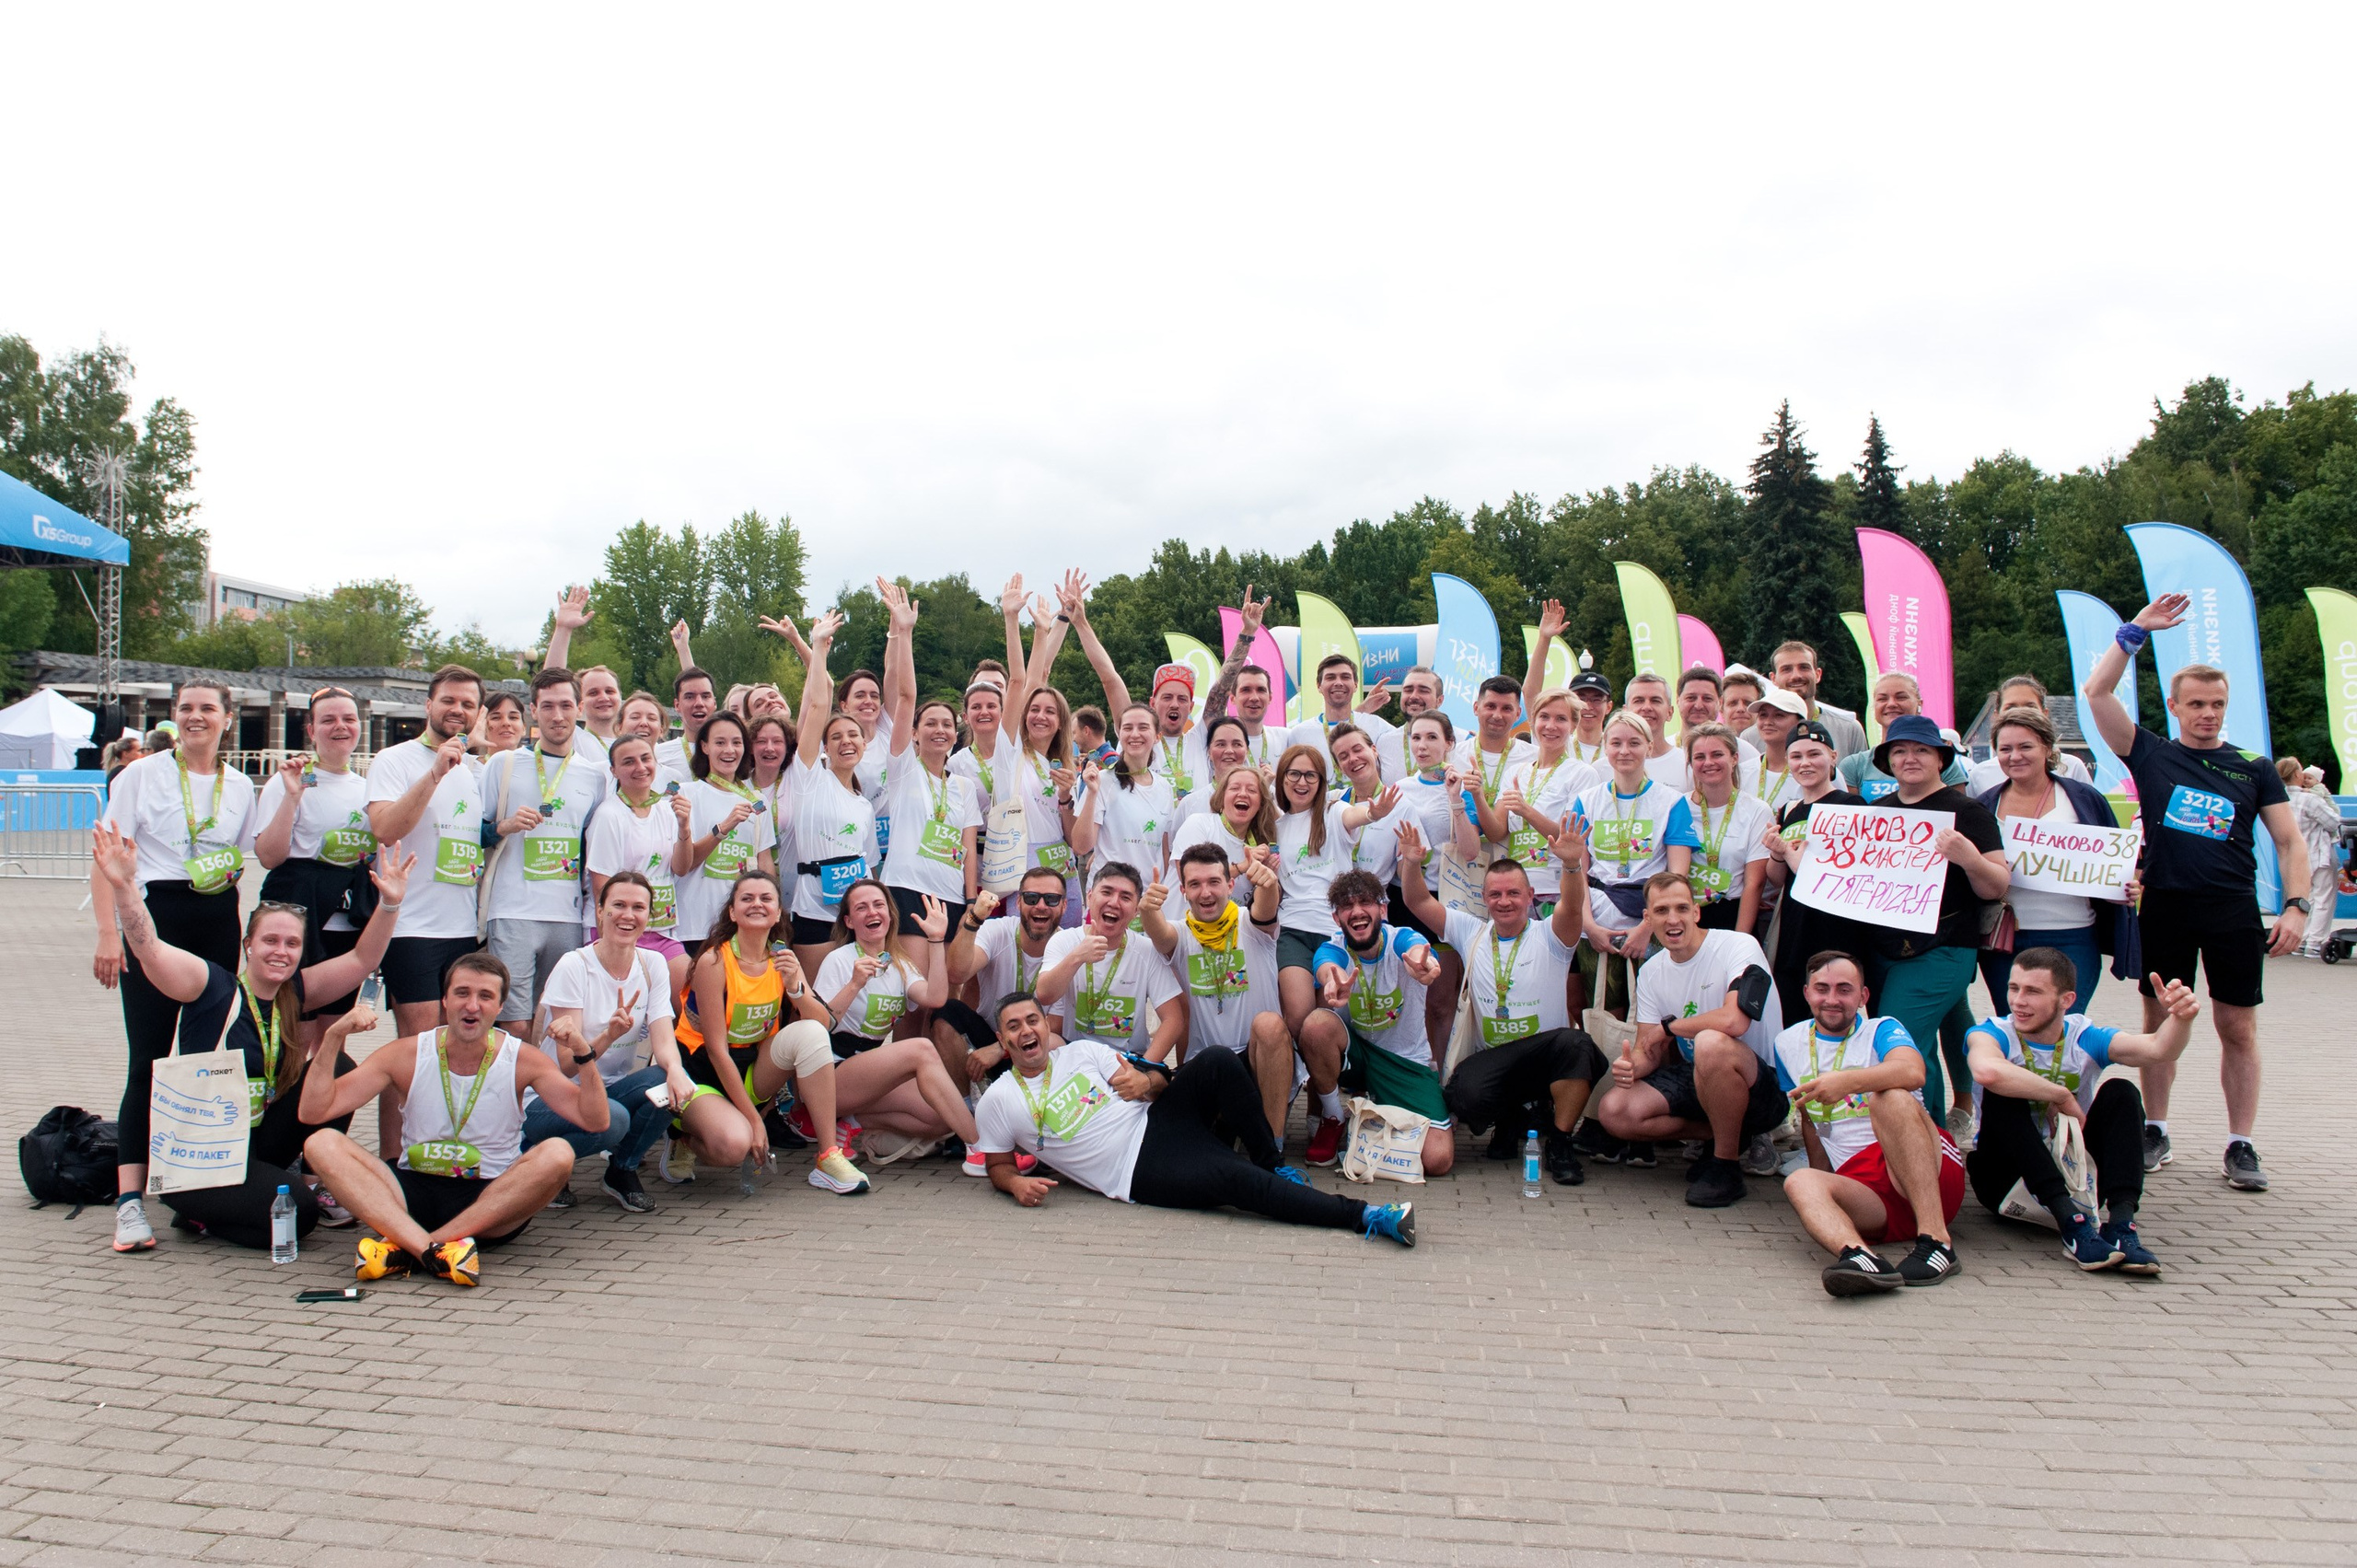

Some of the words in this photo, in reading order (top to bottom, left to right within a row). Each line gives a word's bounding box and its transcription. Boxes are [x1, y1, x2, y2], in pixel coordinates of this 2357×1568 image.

[1363, 646, 1399, 668] ИЗНИ
[2181, 790, 2223, 813] 3212
[1603, 822, 1643, 835] 148
[1811, 810, 1933, 845] ЩЕЛКОВО
[334, 830, 371, 847] 1334
[537, 840, 569, 854] 1321
[1514, 831, 1538, 846] 1355
[2103, 832, 2139, 859] 38
[451, 842, 478, 859] 1319
[717, 842, 748, 858] 1586
[1816, 836, 1856, 869] 38
[195, 851, 235, 874] 1360
[830, 862, 862, 880] 3201
[2011, 851, 2123, 887] ЛУЧШИЕ
[1689, 865, 1721, 886] 348
[653, 888, 673, 901] 323
[1197, 954, 1236, 970] 182
[877, 997, 903, 1012] 1566
[1097, 998, 1124, 1013] 62
[1358, 996, 1394, 1009] 139
[1491, 1019, 1529, 1034] 1385
[210, 1068, 234, 1076] пакет
[249, 1081, 266, 1098] 33
[1046, 1081, 1080, 1114] 1377
[158, 1095, 170, 1105] БЫ
[170, 1101, 197, 1115] ОБНЯЛ
[170, 1147, 187, 1157] НО
[189, 1150, 196, 1159] Я
[197, 1150, 231, 1160] ПАКЕТ
[422, 1142, 468, 1163] 1352
